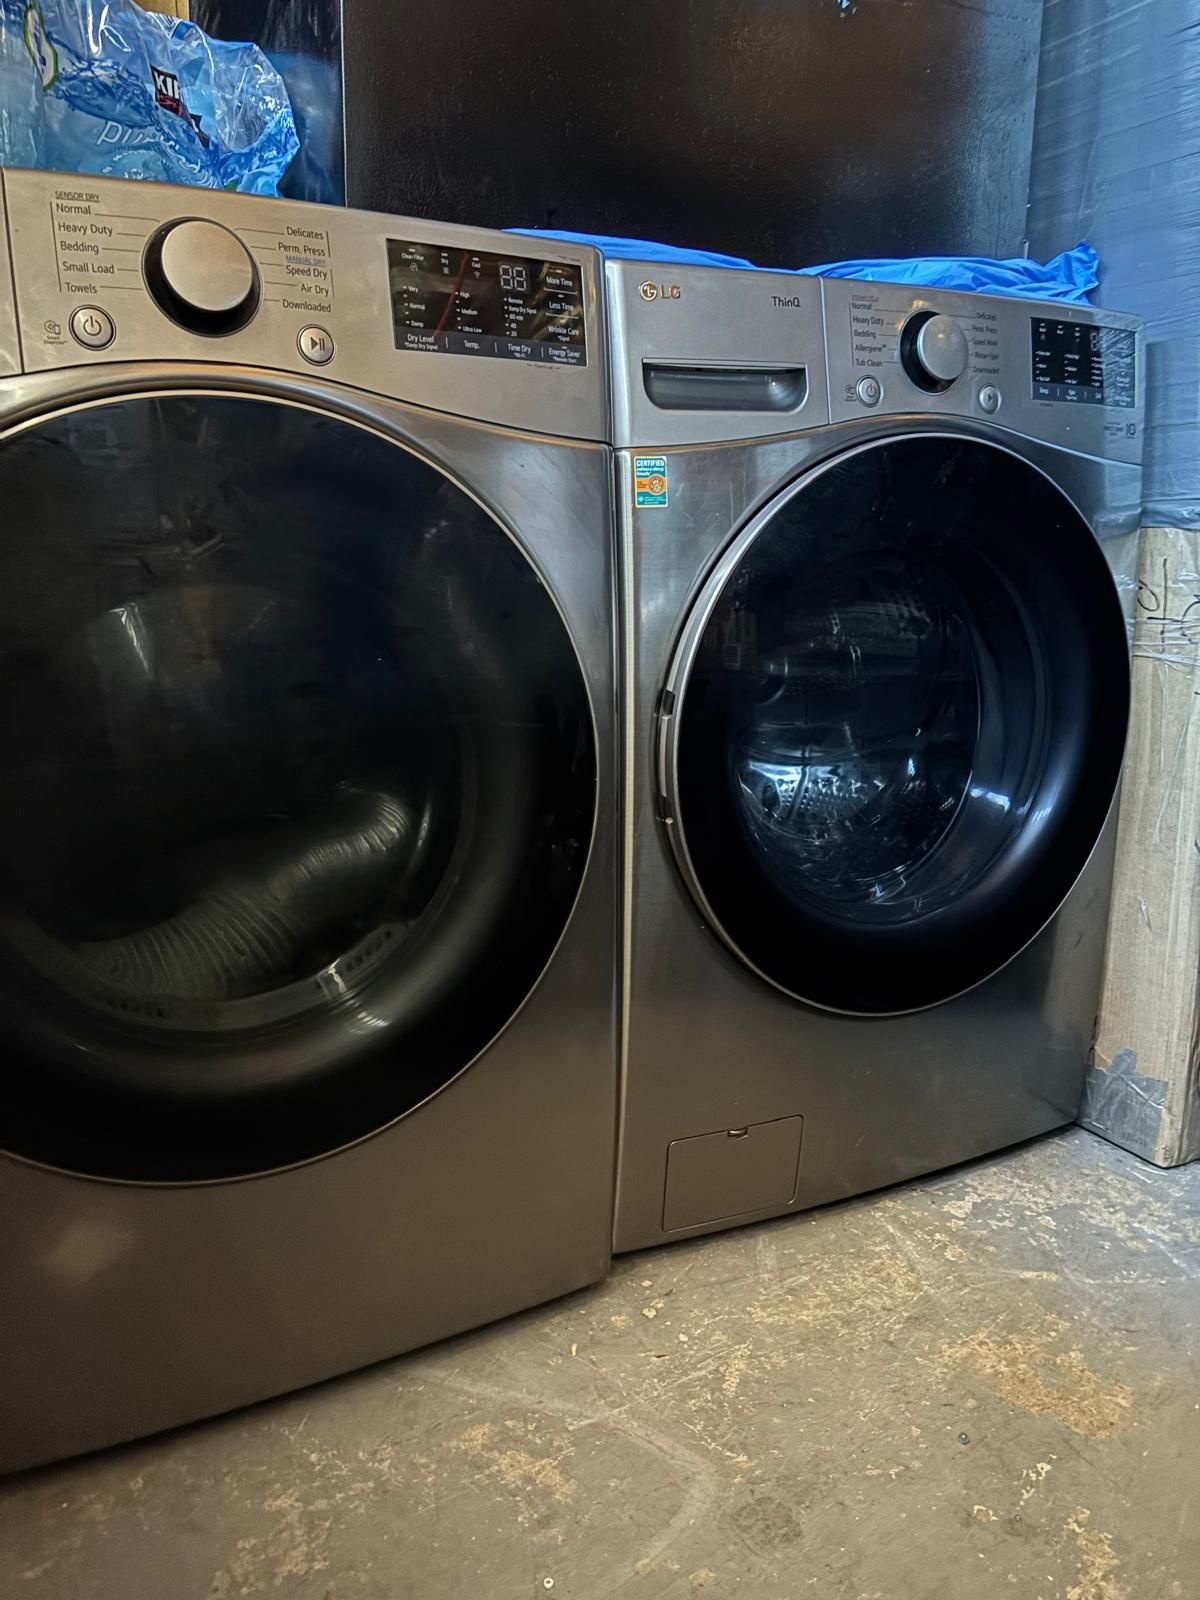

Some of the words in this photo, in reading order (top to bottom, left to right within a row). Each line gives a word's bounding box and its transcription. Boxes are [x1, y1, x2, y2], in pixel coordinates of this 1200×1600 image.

[55, 191, 84, 200] SENSOR
[86, 193, 100, 201] DRY
[56, 203, 91, 215] Normal
[58, 222, 87, 235] Heavy
[90, 224, 113, 237] Duty
[286, 226, 324, 240] Delicates
[60, 241, 99, 254] Bedding
[278, 241, 301, 254] Perm.
[303, 245, 326, 257] Press
[62, 261, 89, 272] Small
[92, 263, 115, 274] Load
[286, 265, 311, 277] Speed
[313, 268, 327, 280] Dry
[546, 276, 560, 285] More
[561, 278, 573, 286] Time
[64, 282, 98, 294] Towels
[301, 283, 313, 293] Air
[315, 285, 329, 297] Dry
[660, 284, 681, 300] LG
[282, 299, 331, 313] Downloaded
[549, 301, 561, 309] Less
[561, 303, 574, 311] Time
[771, 296, 801, 308] ThinQ
[852, 303, 872, 311] Normal
[853, 316, 870, 325] Heavy
[871, 318, 884, 327] Duty
[567, 327, 579, 336] Care
[854, 330, 877, 339] Bedding
[407, 333, 418, 343] Dry
[419, 335, 434, 343] Level
[464, 340, 480, 349] Temp.
[521, 345, 531, 353] Dry
[549, 347, 566, 357] Energy
[566, 350, 580, 358] Saver
[867, 359, 883, 367] Clean
[636, 459, 665, 467] CERTIFIED
